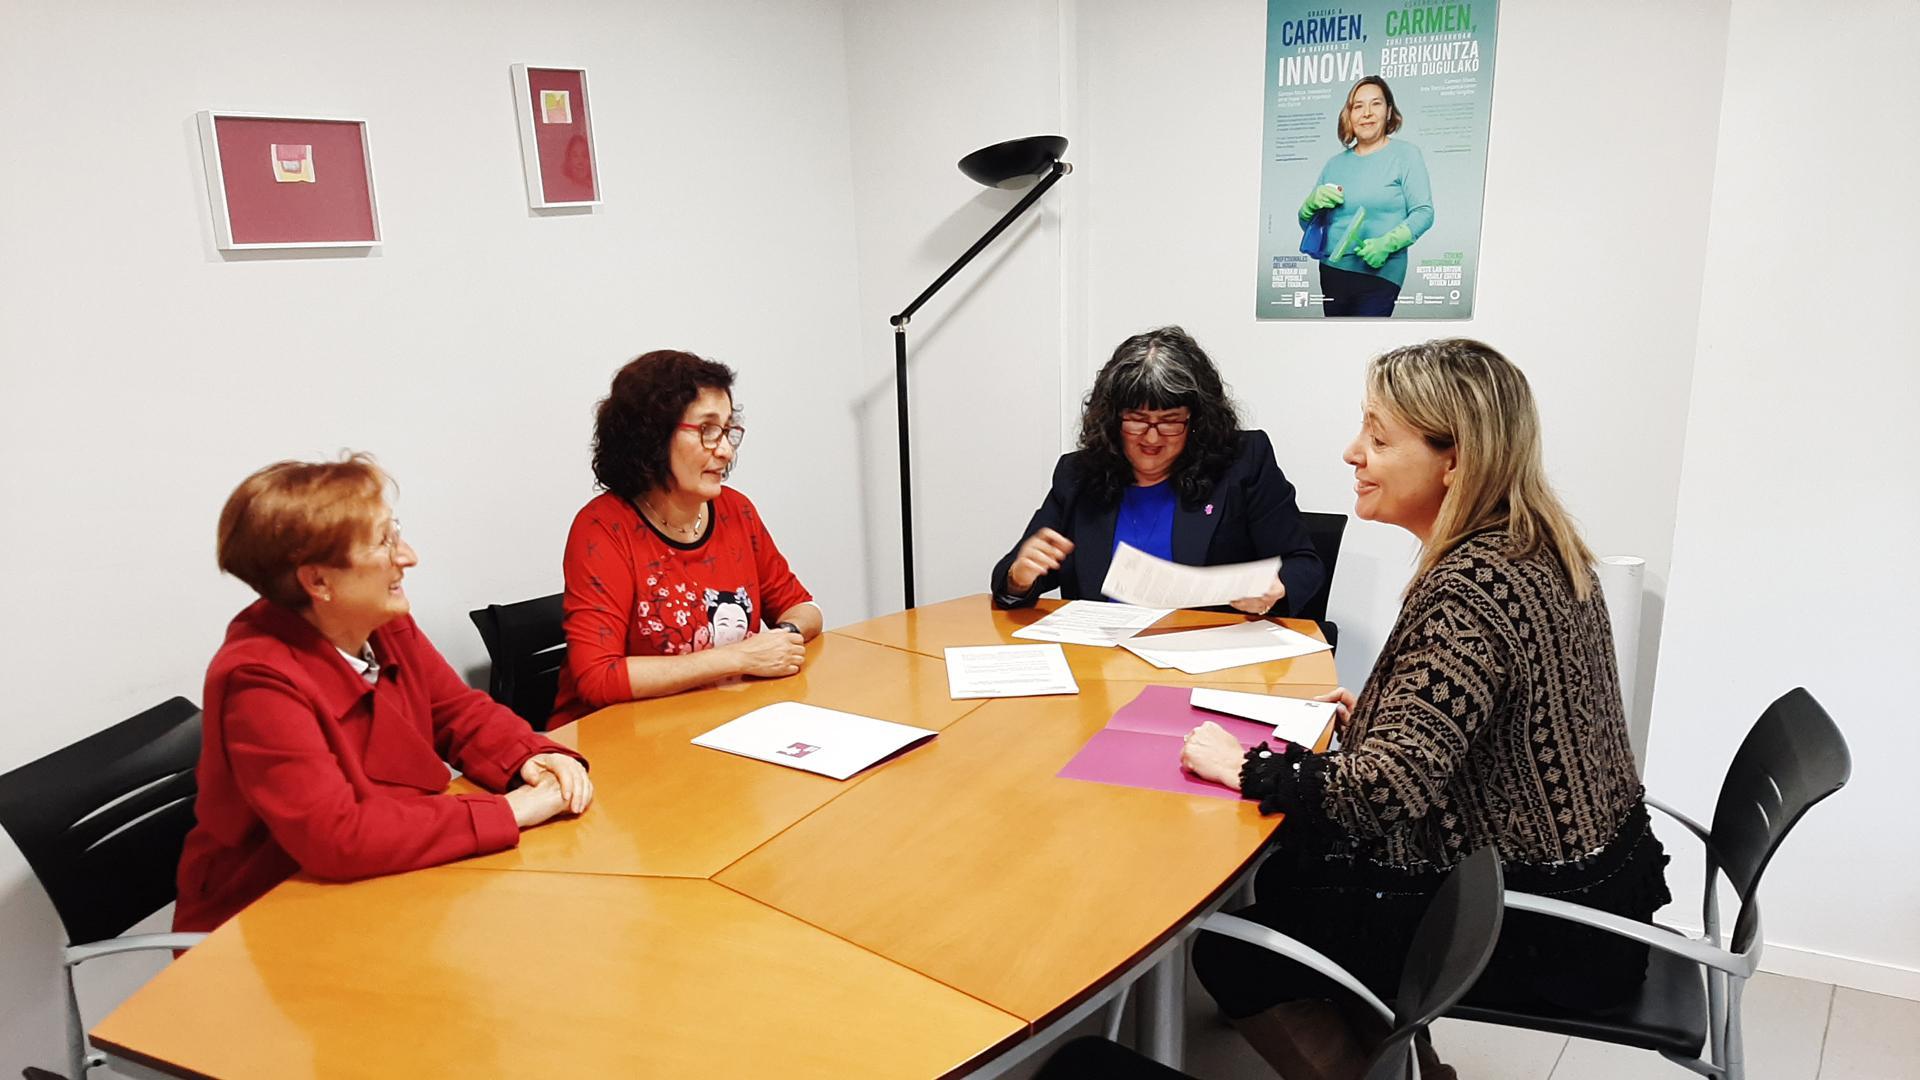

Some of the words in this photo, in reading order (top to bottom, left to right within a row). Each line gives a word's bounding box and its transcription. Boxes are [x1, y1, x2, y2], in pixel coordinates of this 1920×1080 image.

[1282, 14, 1367, 46] CARMEN,
[1386, 4, 1477, 37] CARMEN,
[1279, 50, 1364, 87] INNOVA
[1380, 63, 1418, 79] EGITEN
[1421, 58, 1479, 76] DUGULAKO
[1381, 40, 1479, 66] BERRIKUNTZA
